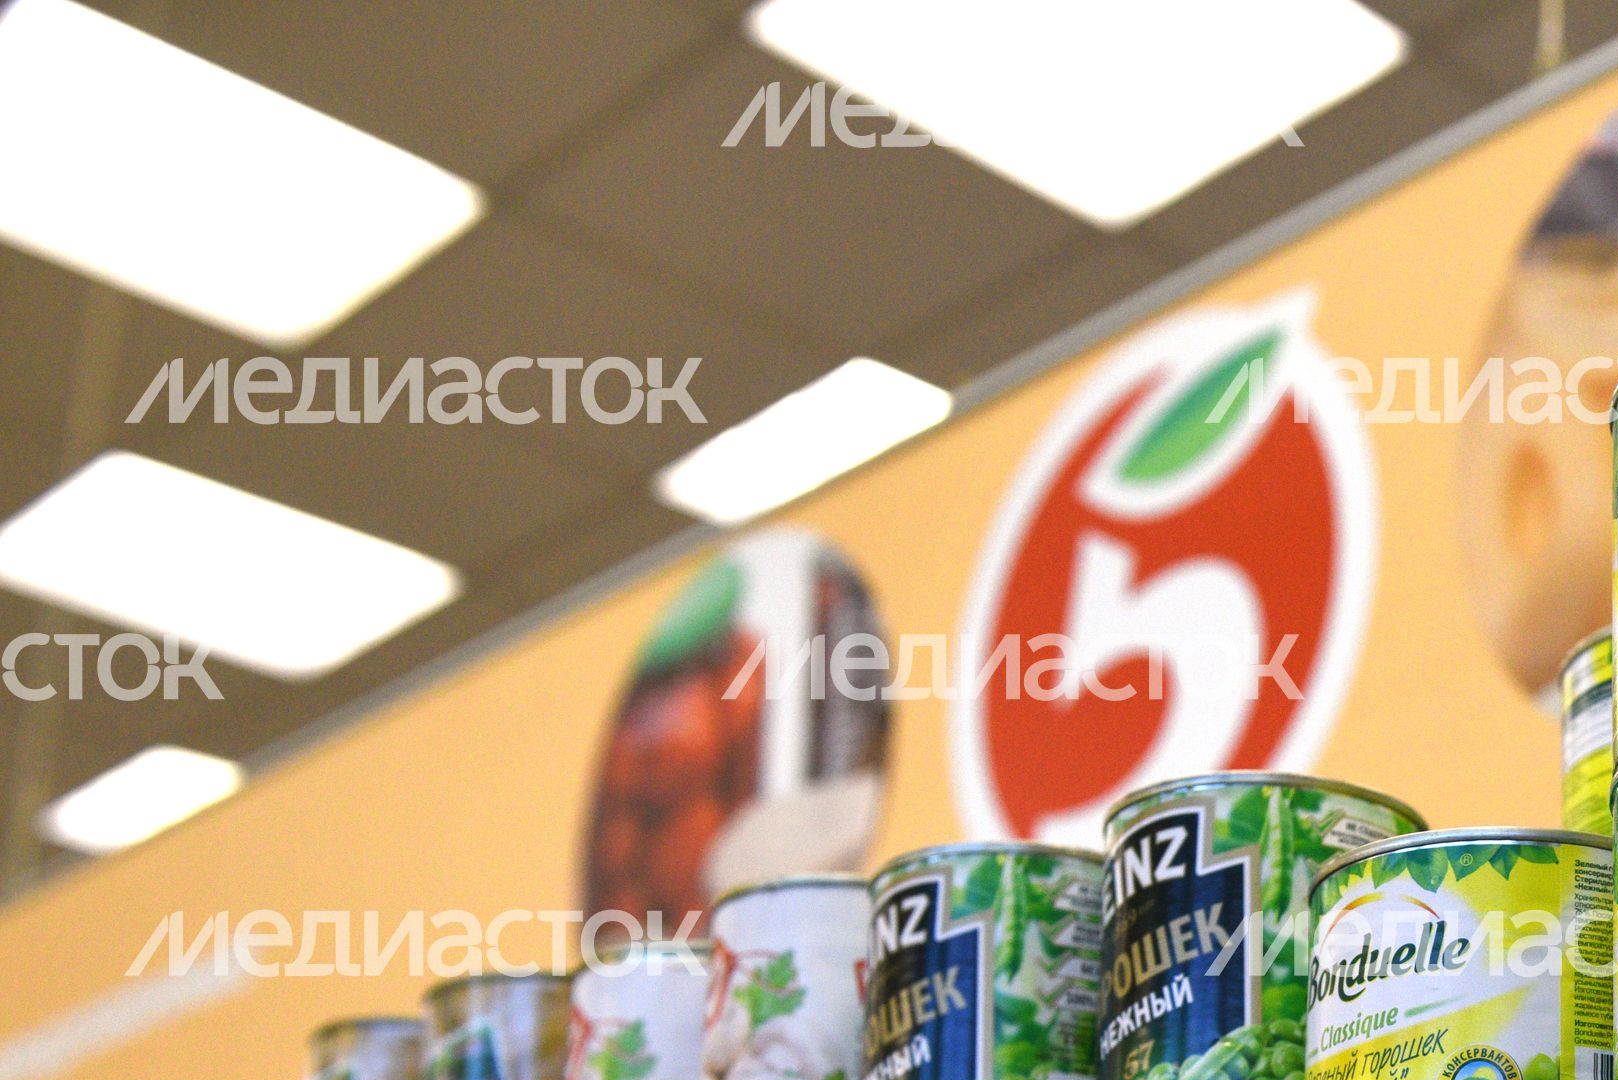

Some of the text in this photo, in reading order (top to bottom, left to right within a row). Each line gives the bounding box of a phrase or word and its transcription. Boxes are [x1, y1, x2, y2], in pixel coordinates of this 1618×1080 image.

[1103, 824, 1189, 927] EINZ
[1101, 901, 1233, 1008] РОШЕК
[1308, 920, 1472, 1012] Bonduelle
[1320, 1006, 1399, 1052] Classique
[1361, 1028, 1449, 1080] горошек
[1443, 1047, 1518, 1080] КОНСЕРВАНТОВ
